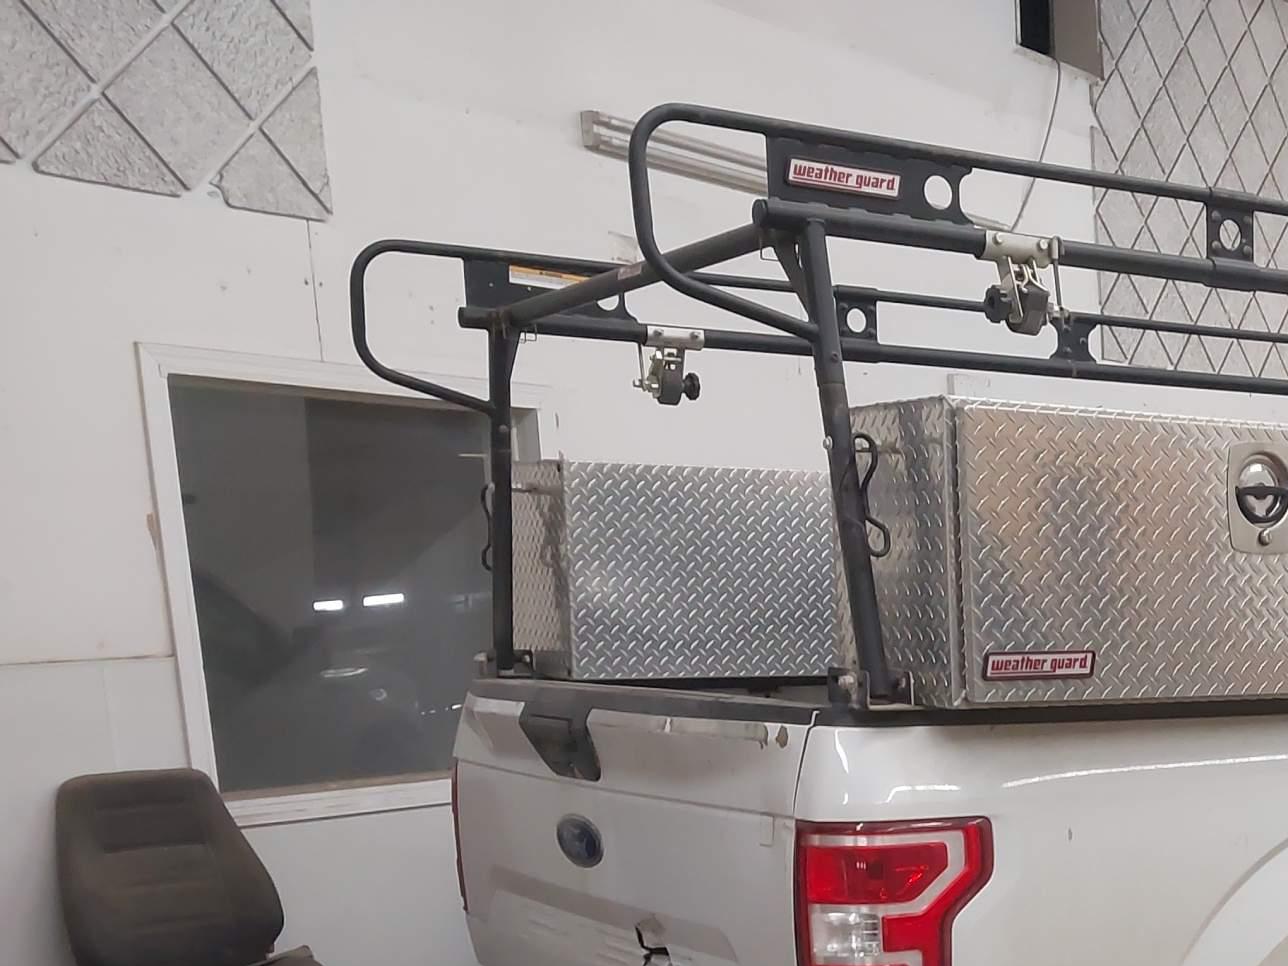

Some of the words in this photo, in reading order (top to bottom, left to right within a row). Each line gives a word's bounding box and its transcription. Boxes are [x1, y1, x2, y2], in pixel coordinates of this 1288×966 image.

[793, 164, 853, 184] weather
[855, 173, 896, 191] guard
[991, 656, 1048, 672] weather
[1050, 655, 1089, 673] guard
